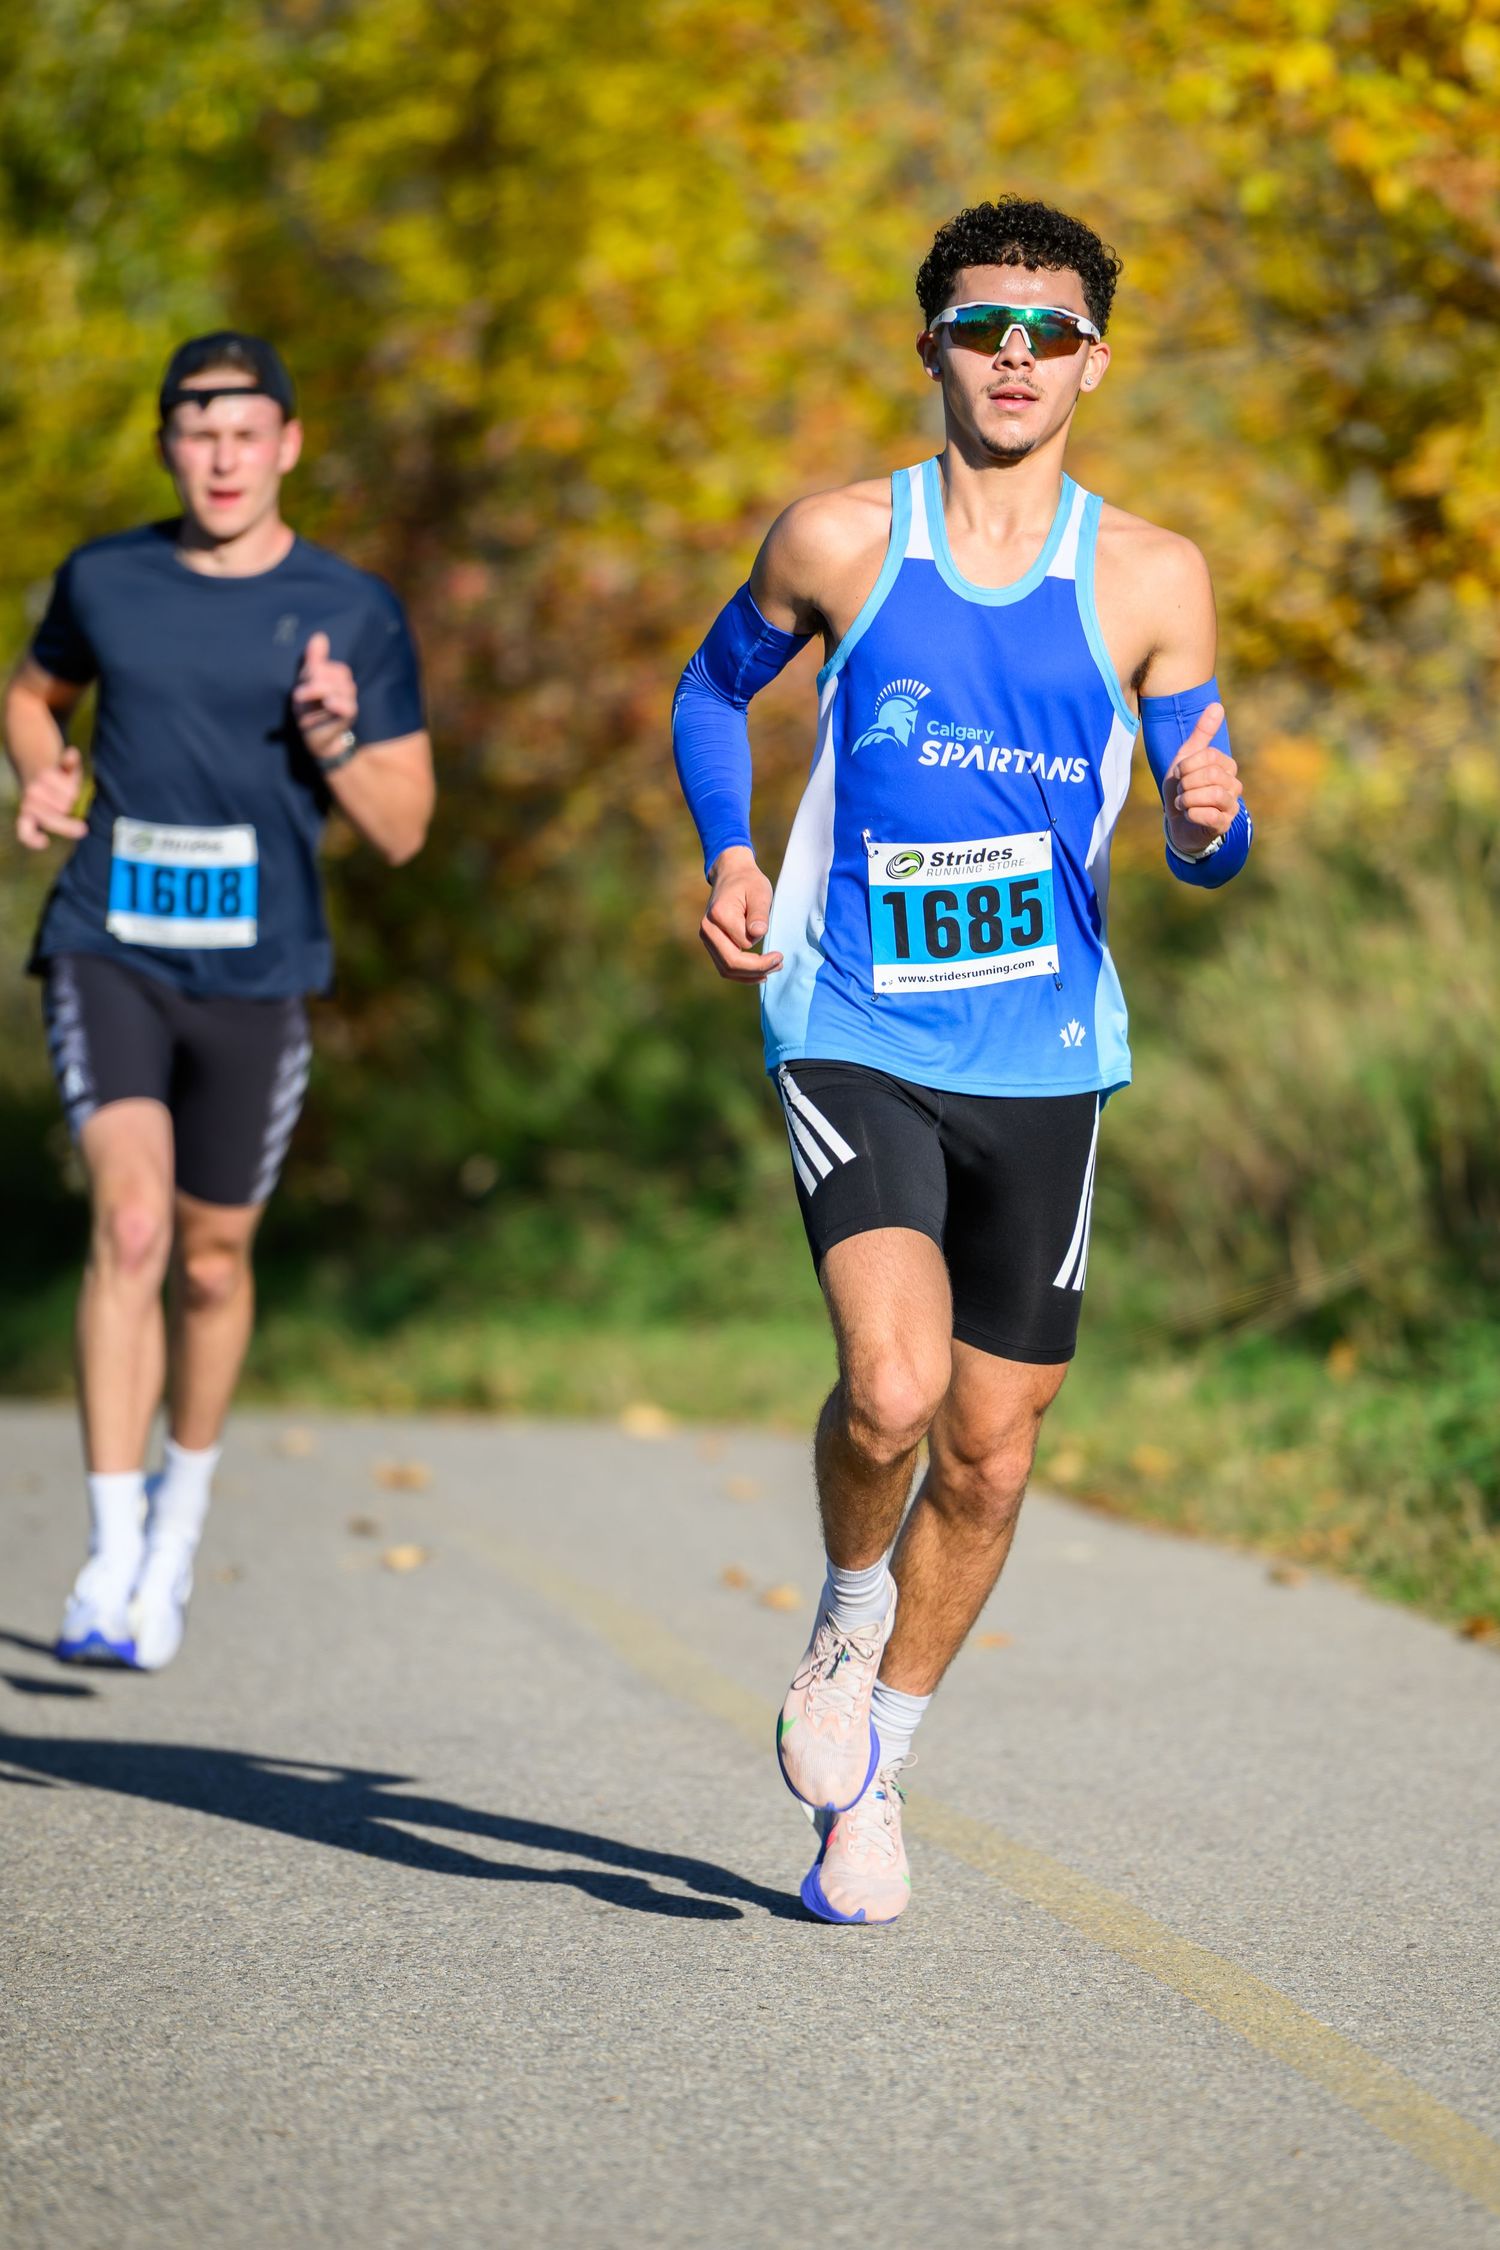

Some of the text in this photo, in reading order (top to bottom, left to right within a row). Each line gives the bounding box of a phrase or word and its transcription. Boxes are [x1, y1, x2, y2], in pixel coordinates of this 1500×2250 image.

[926, 720, 994, 744] Calgary
[918, 740, 1090, 783] SPARTANS
[926, 858, 1025, 877] RUNNING STORE
[930, 847, 1013, 867] Strides
[127, 865, 241, 917] 1608
[882, 878, 1044, 959] 1685
[898, 959, 1035, 984] www.stridesrunning.com
